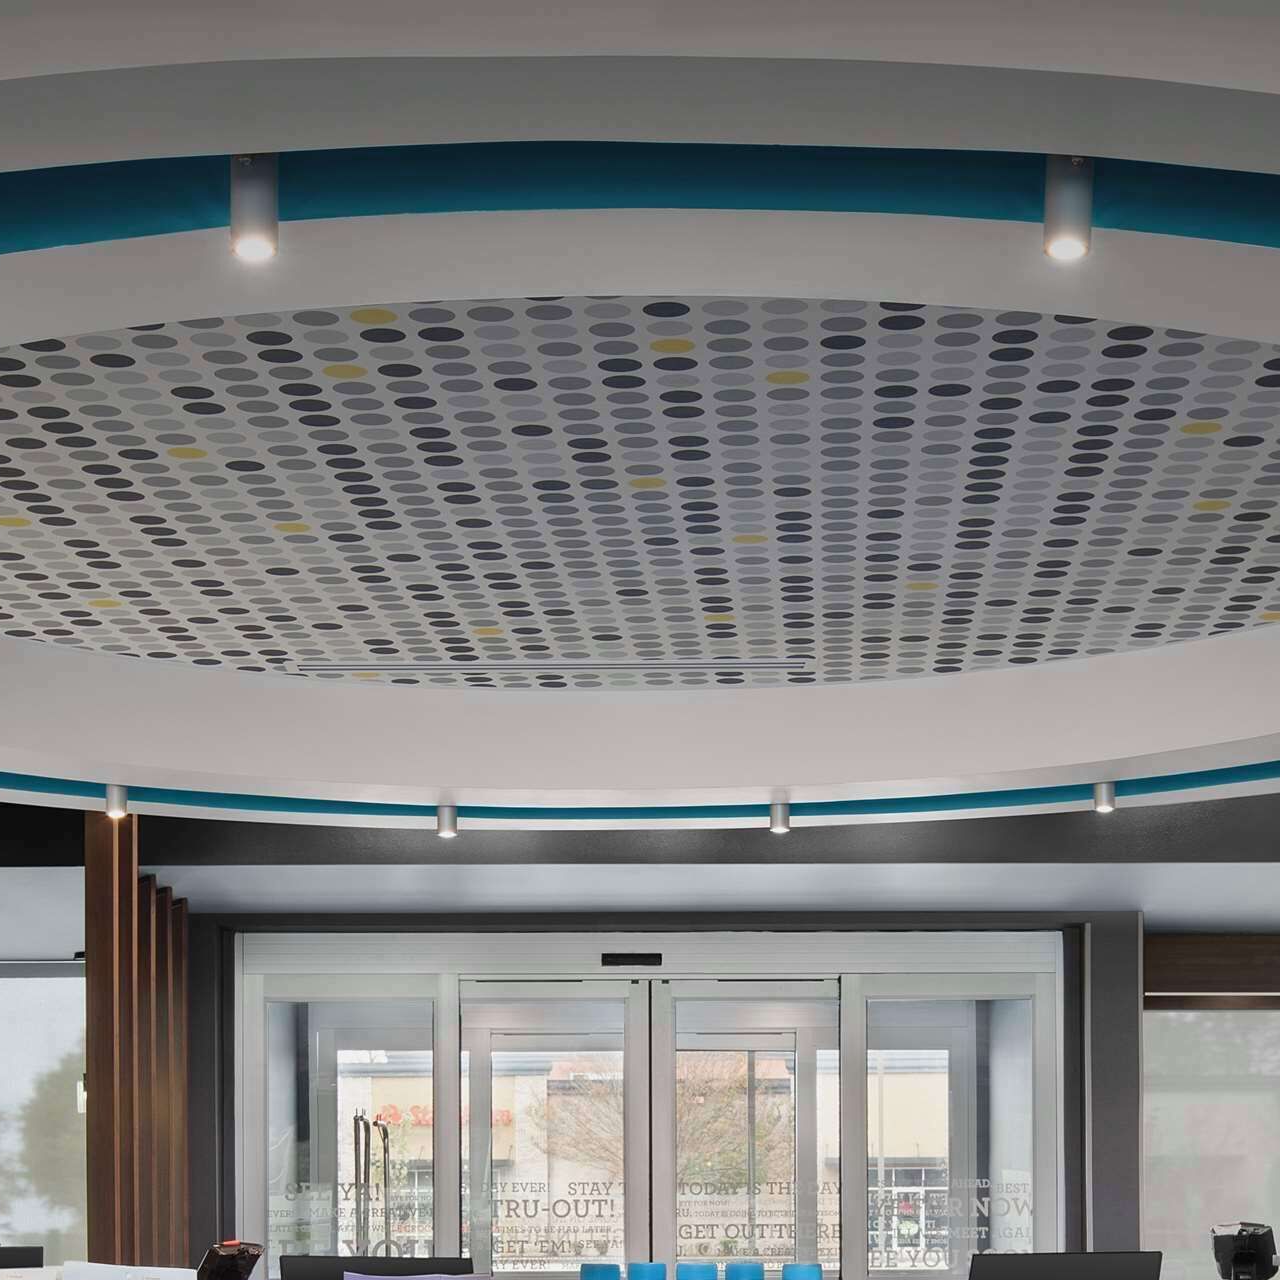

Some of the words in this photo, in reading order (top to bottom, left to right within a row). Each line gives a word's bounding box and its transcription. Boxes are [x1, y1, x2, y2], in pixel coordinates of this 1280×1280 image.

[339, 1183, 380, 1200] YA!
[568, 1182, 613, 1196] STAY
[680, 1182, 738, 1195] TODAY
[491, 1199, 615, 1218] TRU-OUT!
[971, 1198, 1034, 1217] NOW
[679, 1224, 719, 1239] GET
[493, 1240, 528, 1254] GET
